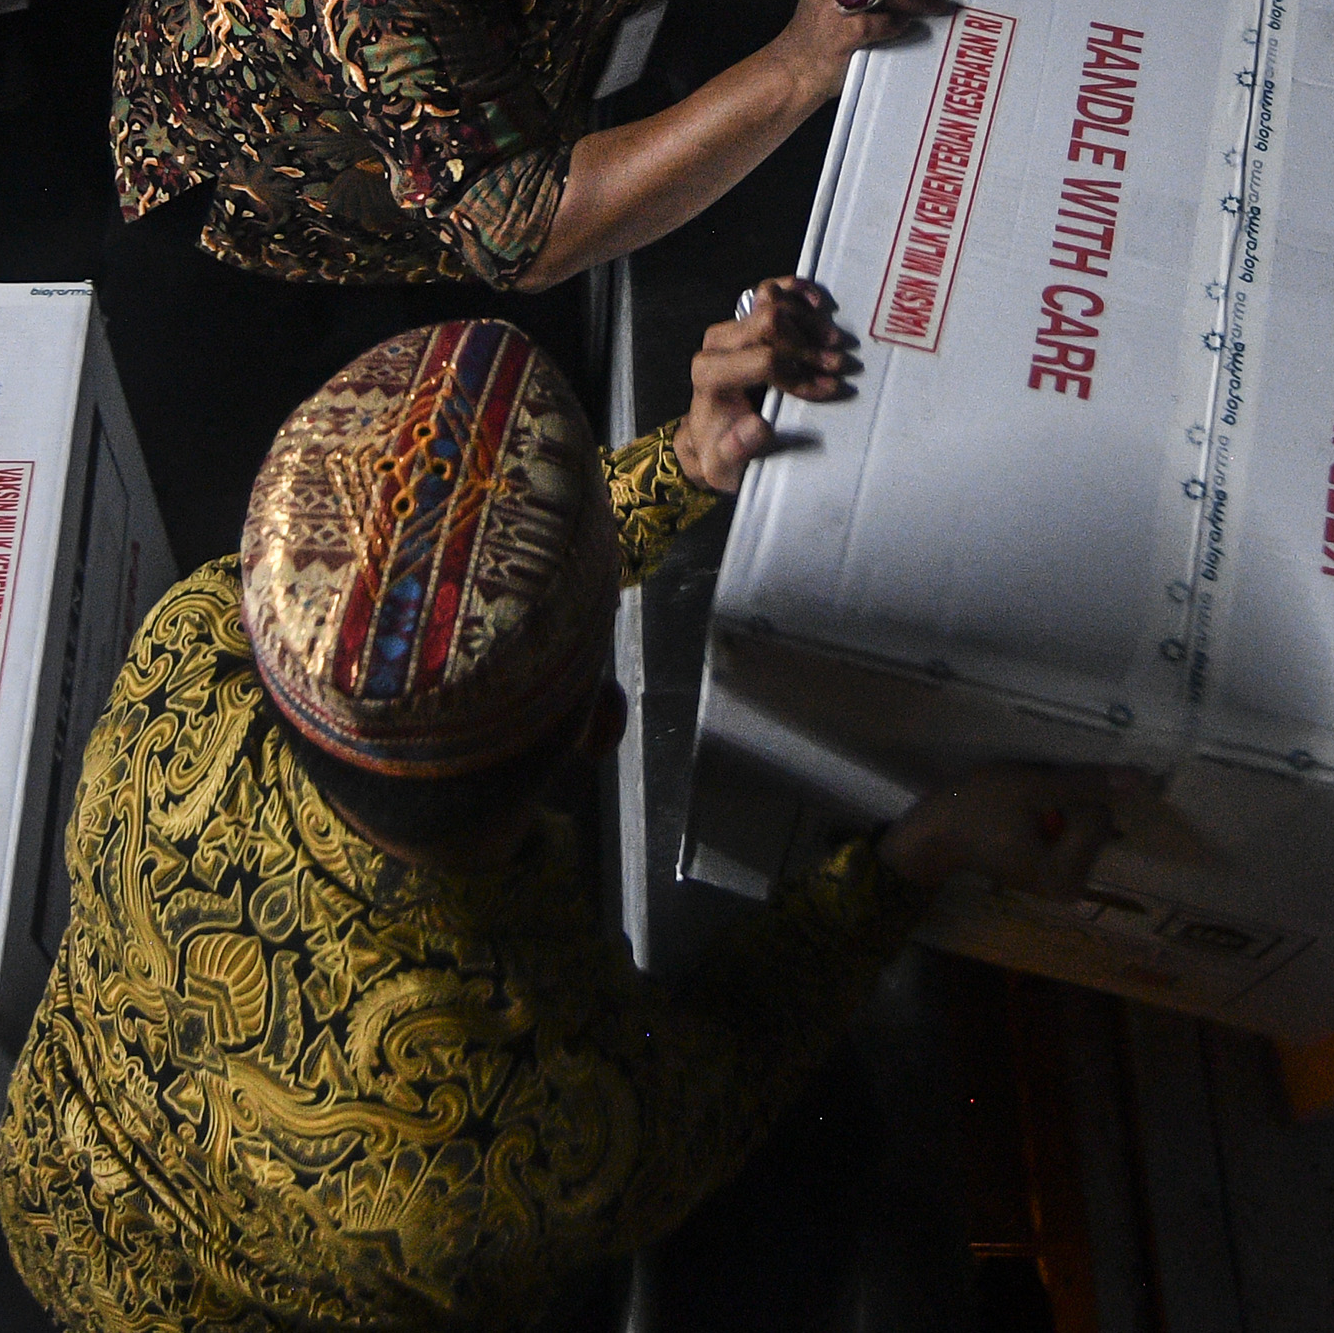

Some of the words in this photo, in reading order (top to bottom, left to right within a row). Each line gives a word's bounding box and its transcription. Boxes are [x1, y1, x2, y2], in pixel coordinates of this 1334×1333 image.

[964, 14, 1003, 34] RI
[942, 32, 999, 120] KESEHATAN
[1067, 22, 1144, 171] HANDLE
[914, 116, 979, 229] KEMENTERIAN
[901, 225, 950, 277] MILIK
[1049, 177, 1122, 278] WITH
[1220, 342, 1245, 426] biofarma
[1238, 206, 1261, 283] biofarma
[1253, 79, 1275, 152] biofarma
[884, 274, 939, 337] VAKSIN
[1028, 284, 1105, 400] CARE
